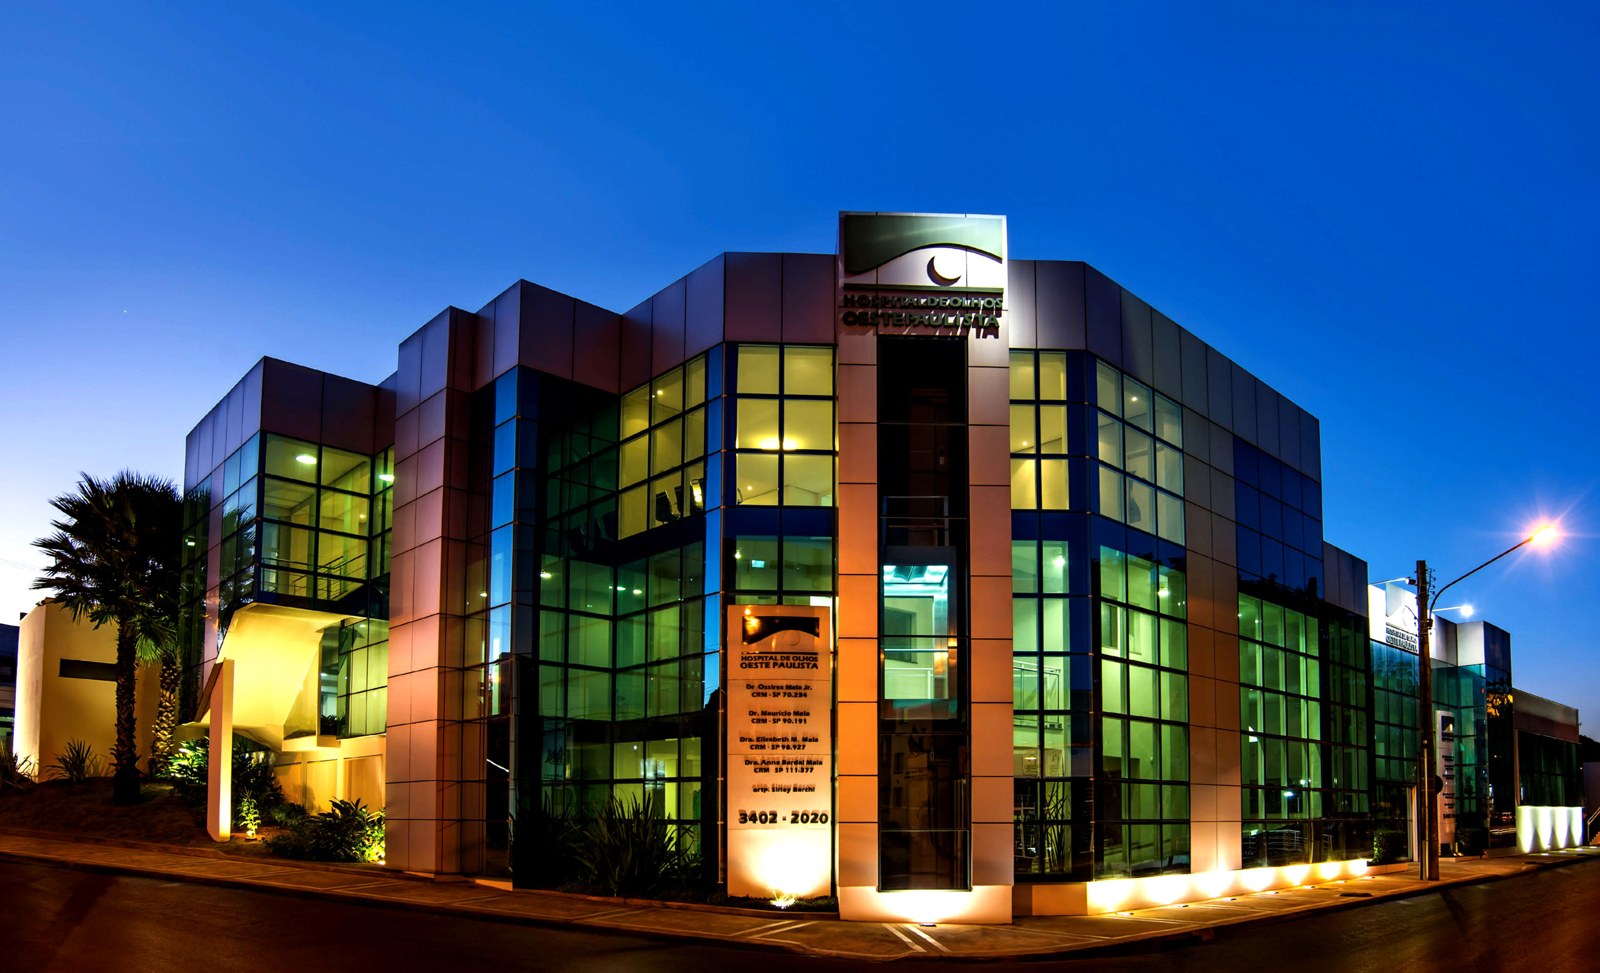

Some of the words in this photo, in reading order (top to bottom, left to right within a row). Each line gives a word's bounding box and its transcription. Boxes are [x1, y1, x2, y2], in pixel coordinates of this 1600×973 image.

[842, 310, 905, 327] OESTE
[905, 311, 1000, 328] PAULISTA
[739, 812, 778, 824] 3402
[790, 812, 829, 824] 2020
